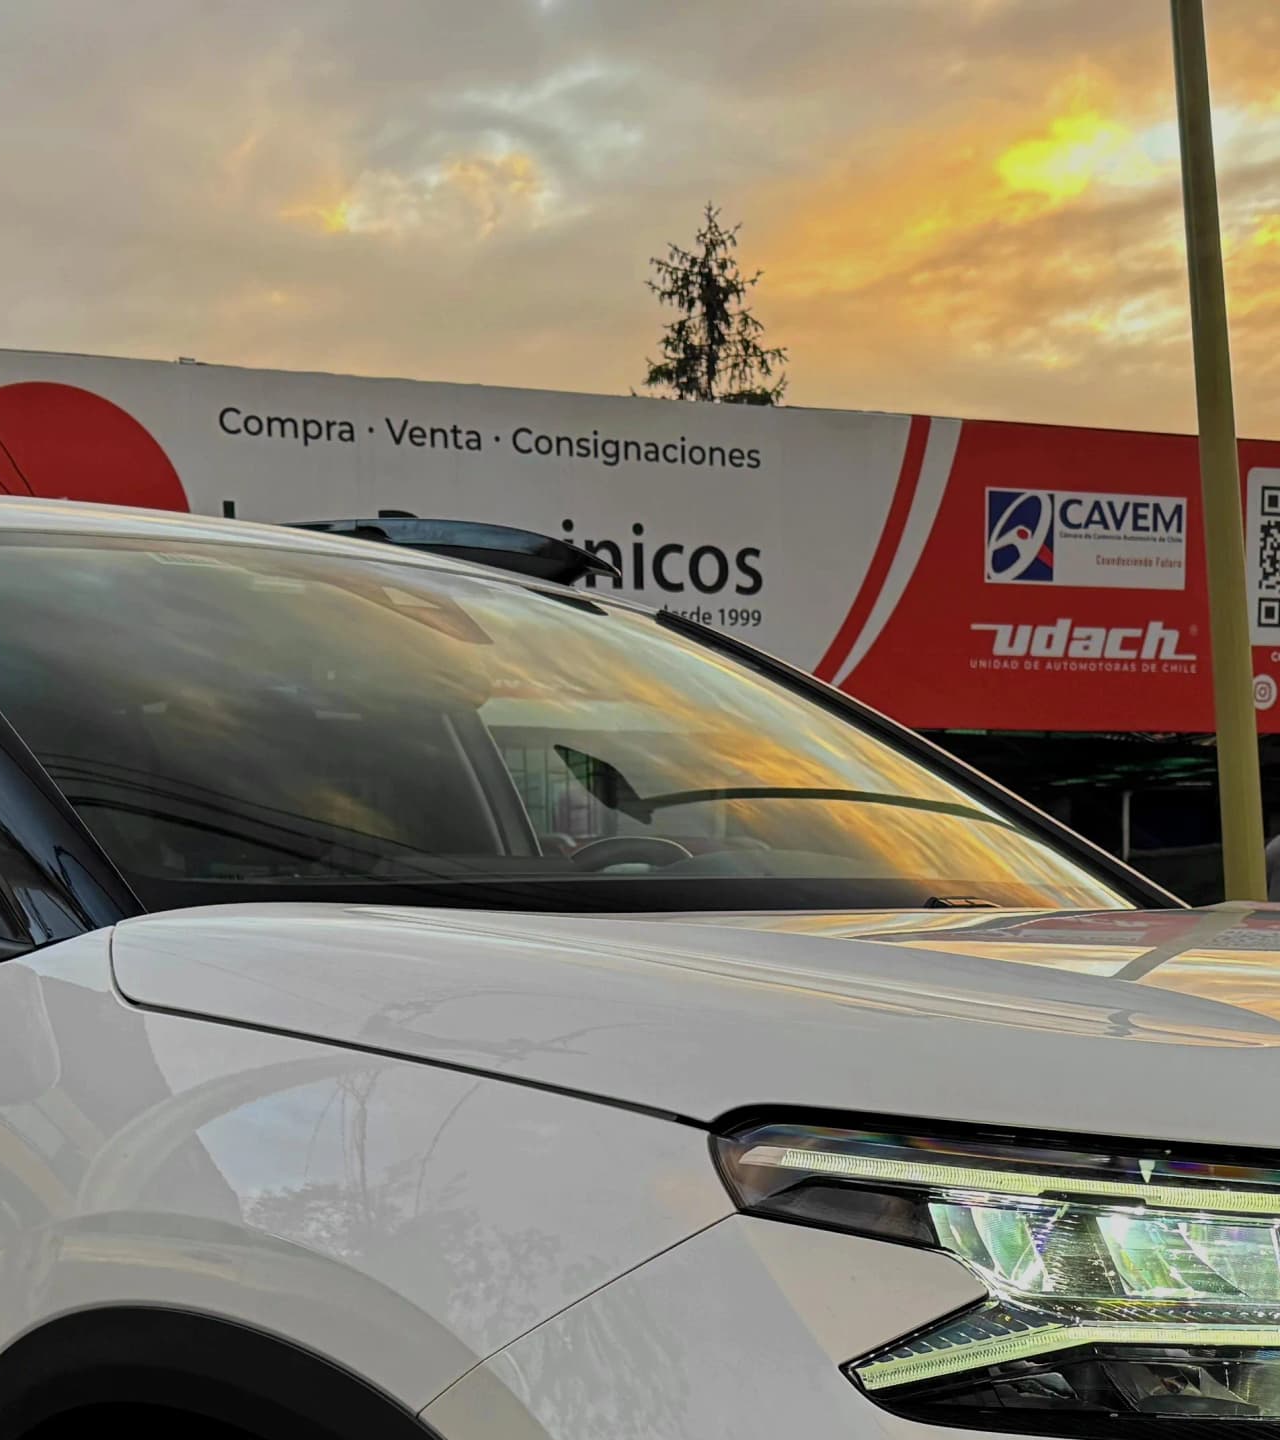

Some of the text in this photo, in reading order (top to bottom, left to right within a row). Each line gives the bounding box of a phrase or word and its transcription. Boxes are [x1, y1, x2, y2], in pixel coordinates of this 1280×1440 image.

[219, 407, 761, 469] Compra Venta Consignaciones
[1059, 499, 1183, 533] CAVEM
[718, 608, 762, 627] 1999
[971, 618, 1197, 660] udach
[970, 659, 1198, 674] UNIDAD DE AUTOMOTORAS DE CHILE
